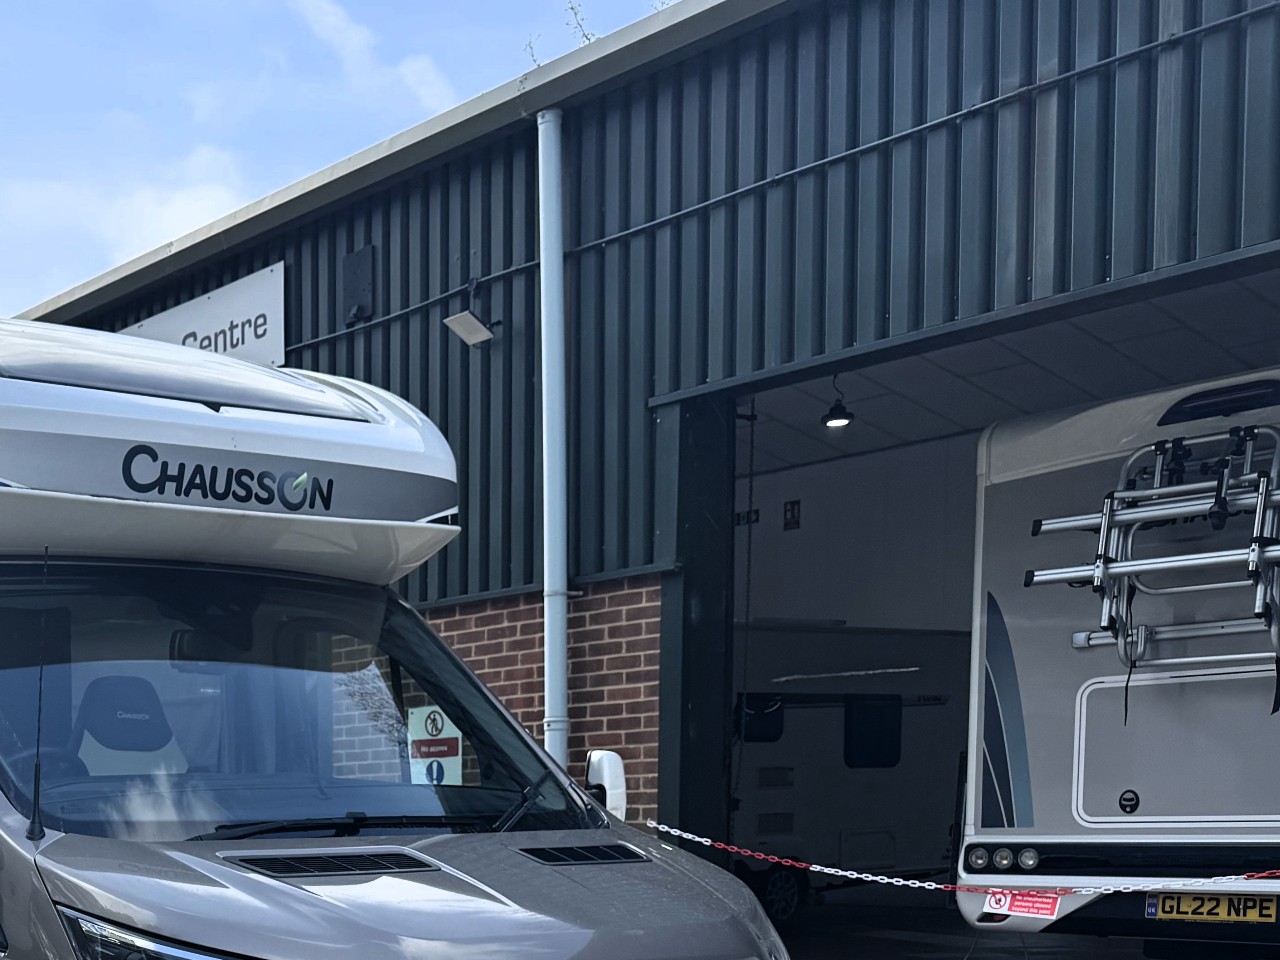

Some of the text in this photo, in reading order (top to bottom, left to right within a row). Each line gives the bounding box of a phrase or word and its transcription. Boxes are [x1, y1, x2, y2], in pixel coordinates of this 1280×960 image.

[122, 444, 334, 512] CHAUSSON
[1161, 895, 1274, 918] GL22 NPE
